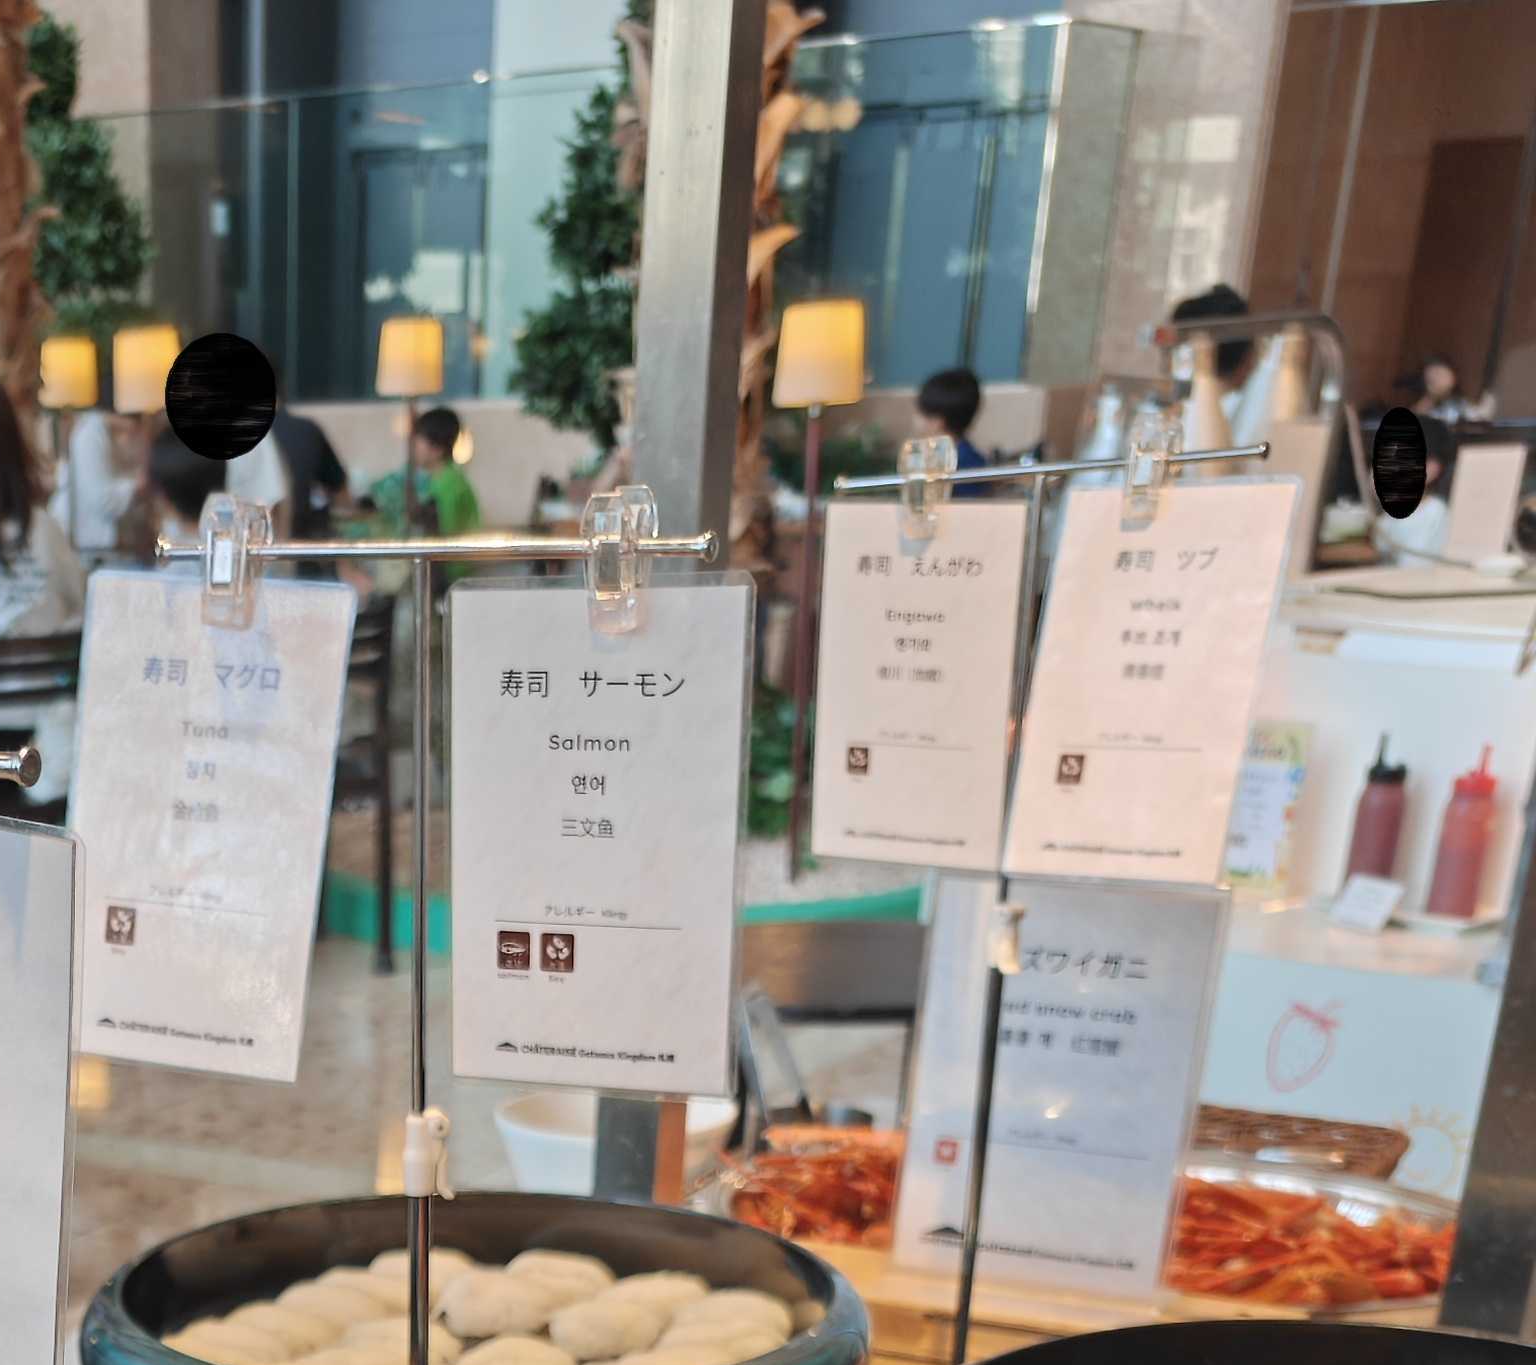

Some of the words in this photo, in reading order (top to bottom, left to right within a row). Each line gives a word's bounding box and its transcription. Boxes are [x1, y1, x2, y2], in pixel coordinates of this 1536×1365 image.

[143, 656, 189, 687] 寿司
[215, 663, 281, 692] マグロ
[499, 669, 549, 698] 寿司
[578, 670, 686, 698] サーモン
[181, 720, 229, 740] Tuna
[548, 734, 631, 752] Salmon
[571, 774, 606, 796] 연어
[561, 817, 615, 839] 三文鱼
